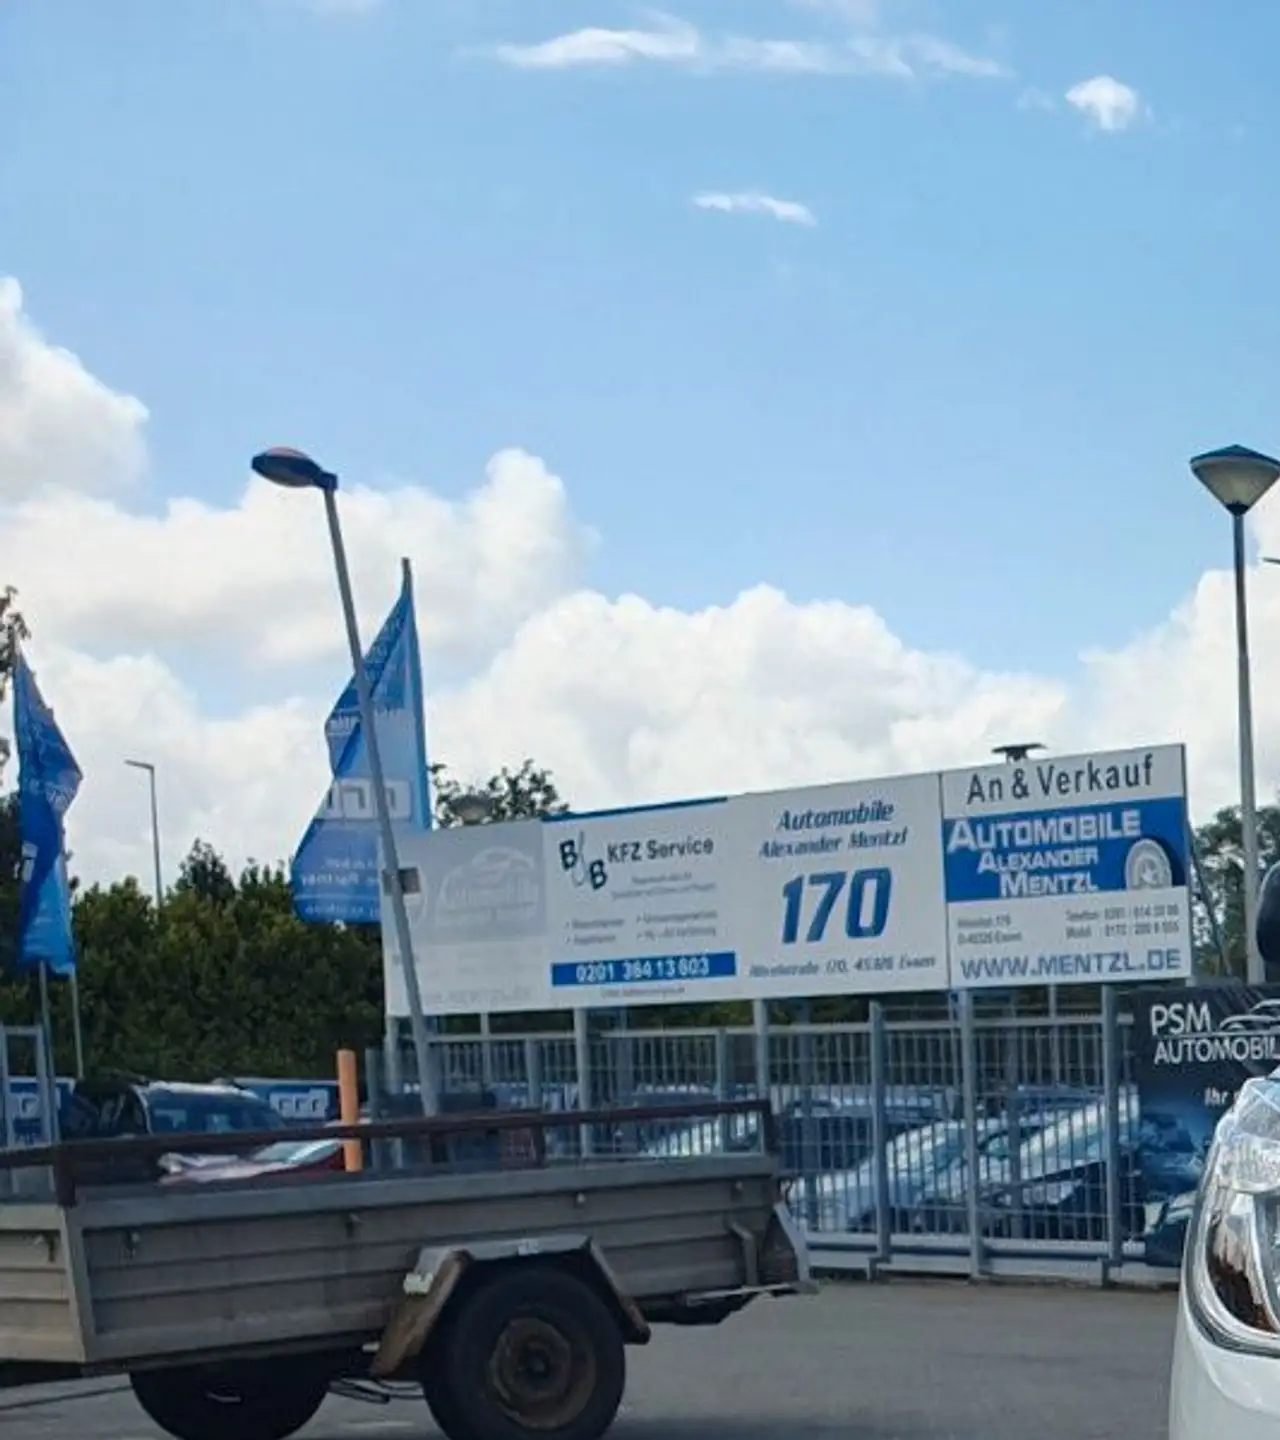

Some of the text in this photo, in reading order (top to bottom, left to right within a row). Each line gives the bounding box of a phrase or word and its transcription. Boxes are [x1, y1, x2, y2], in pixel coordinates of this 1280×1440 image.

[967, 753, 1153, 805] An & Verkauf
[777, 800, 894, 832] Automobile
[948, 809, 1141, 853] AUTOMOBILE
[606, 835, 714, 864] KFZ Service
[759, 836, 843, 858] Alexander
[1001, 872, 1098, 898] MENTZL
[781, 867, 892, 945] 170
[575, 962, 615, 983] 0201
[960, 948, 1182, 980] WWW.MENTZL.DE
[1151, 1001, 1212, 1036] PSM
